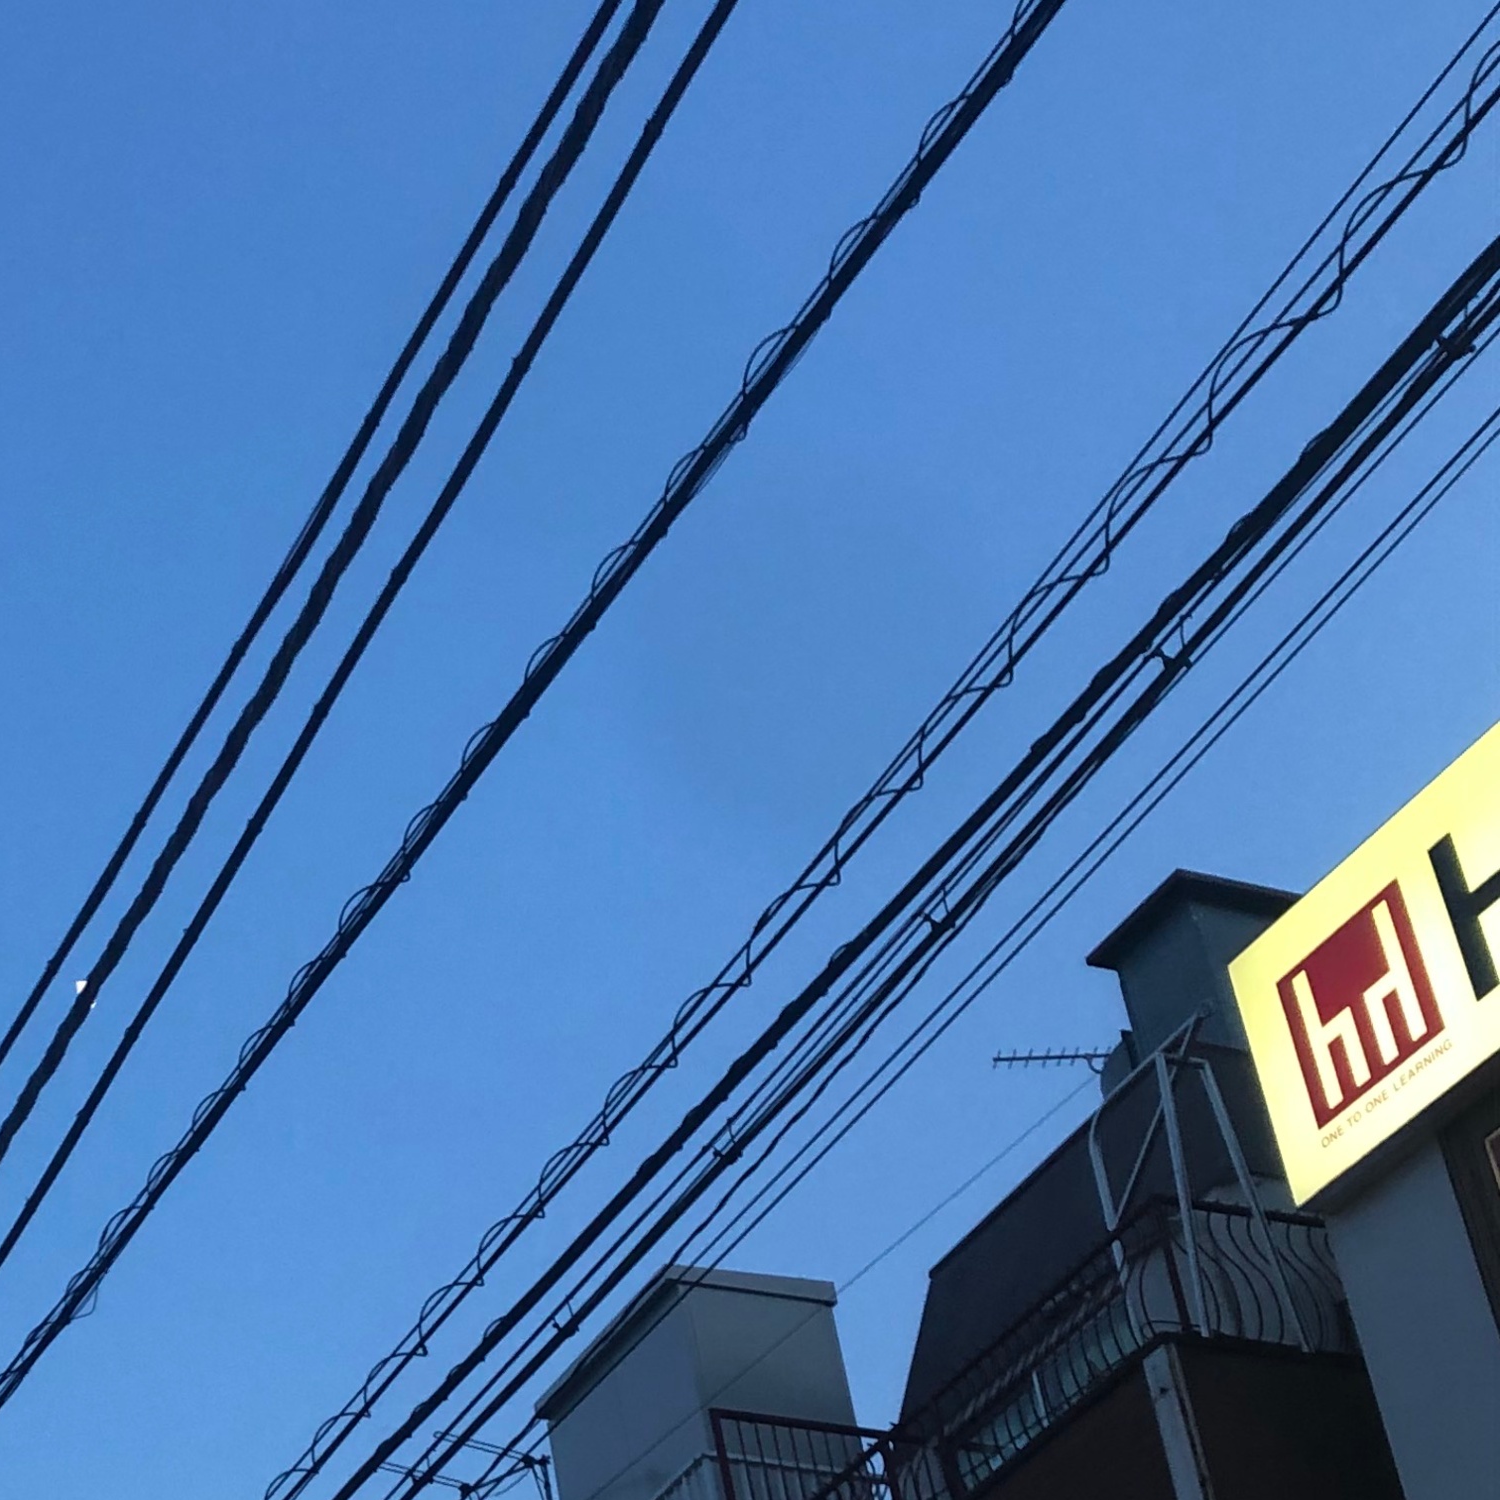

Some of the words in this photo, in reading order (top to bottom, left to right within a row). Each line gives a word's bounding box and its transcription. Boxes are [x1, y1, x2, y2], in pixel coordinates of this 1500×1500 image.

[1320, 1126, 1345, 1149] ONE
[1346, 1110, 1362, 1128] TO
[1364, 1089, 1389, 1113] ONE
[1392, 1038, 1453, 1093] LEARNING
